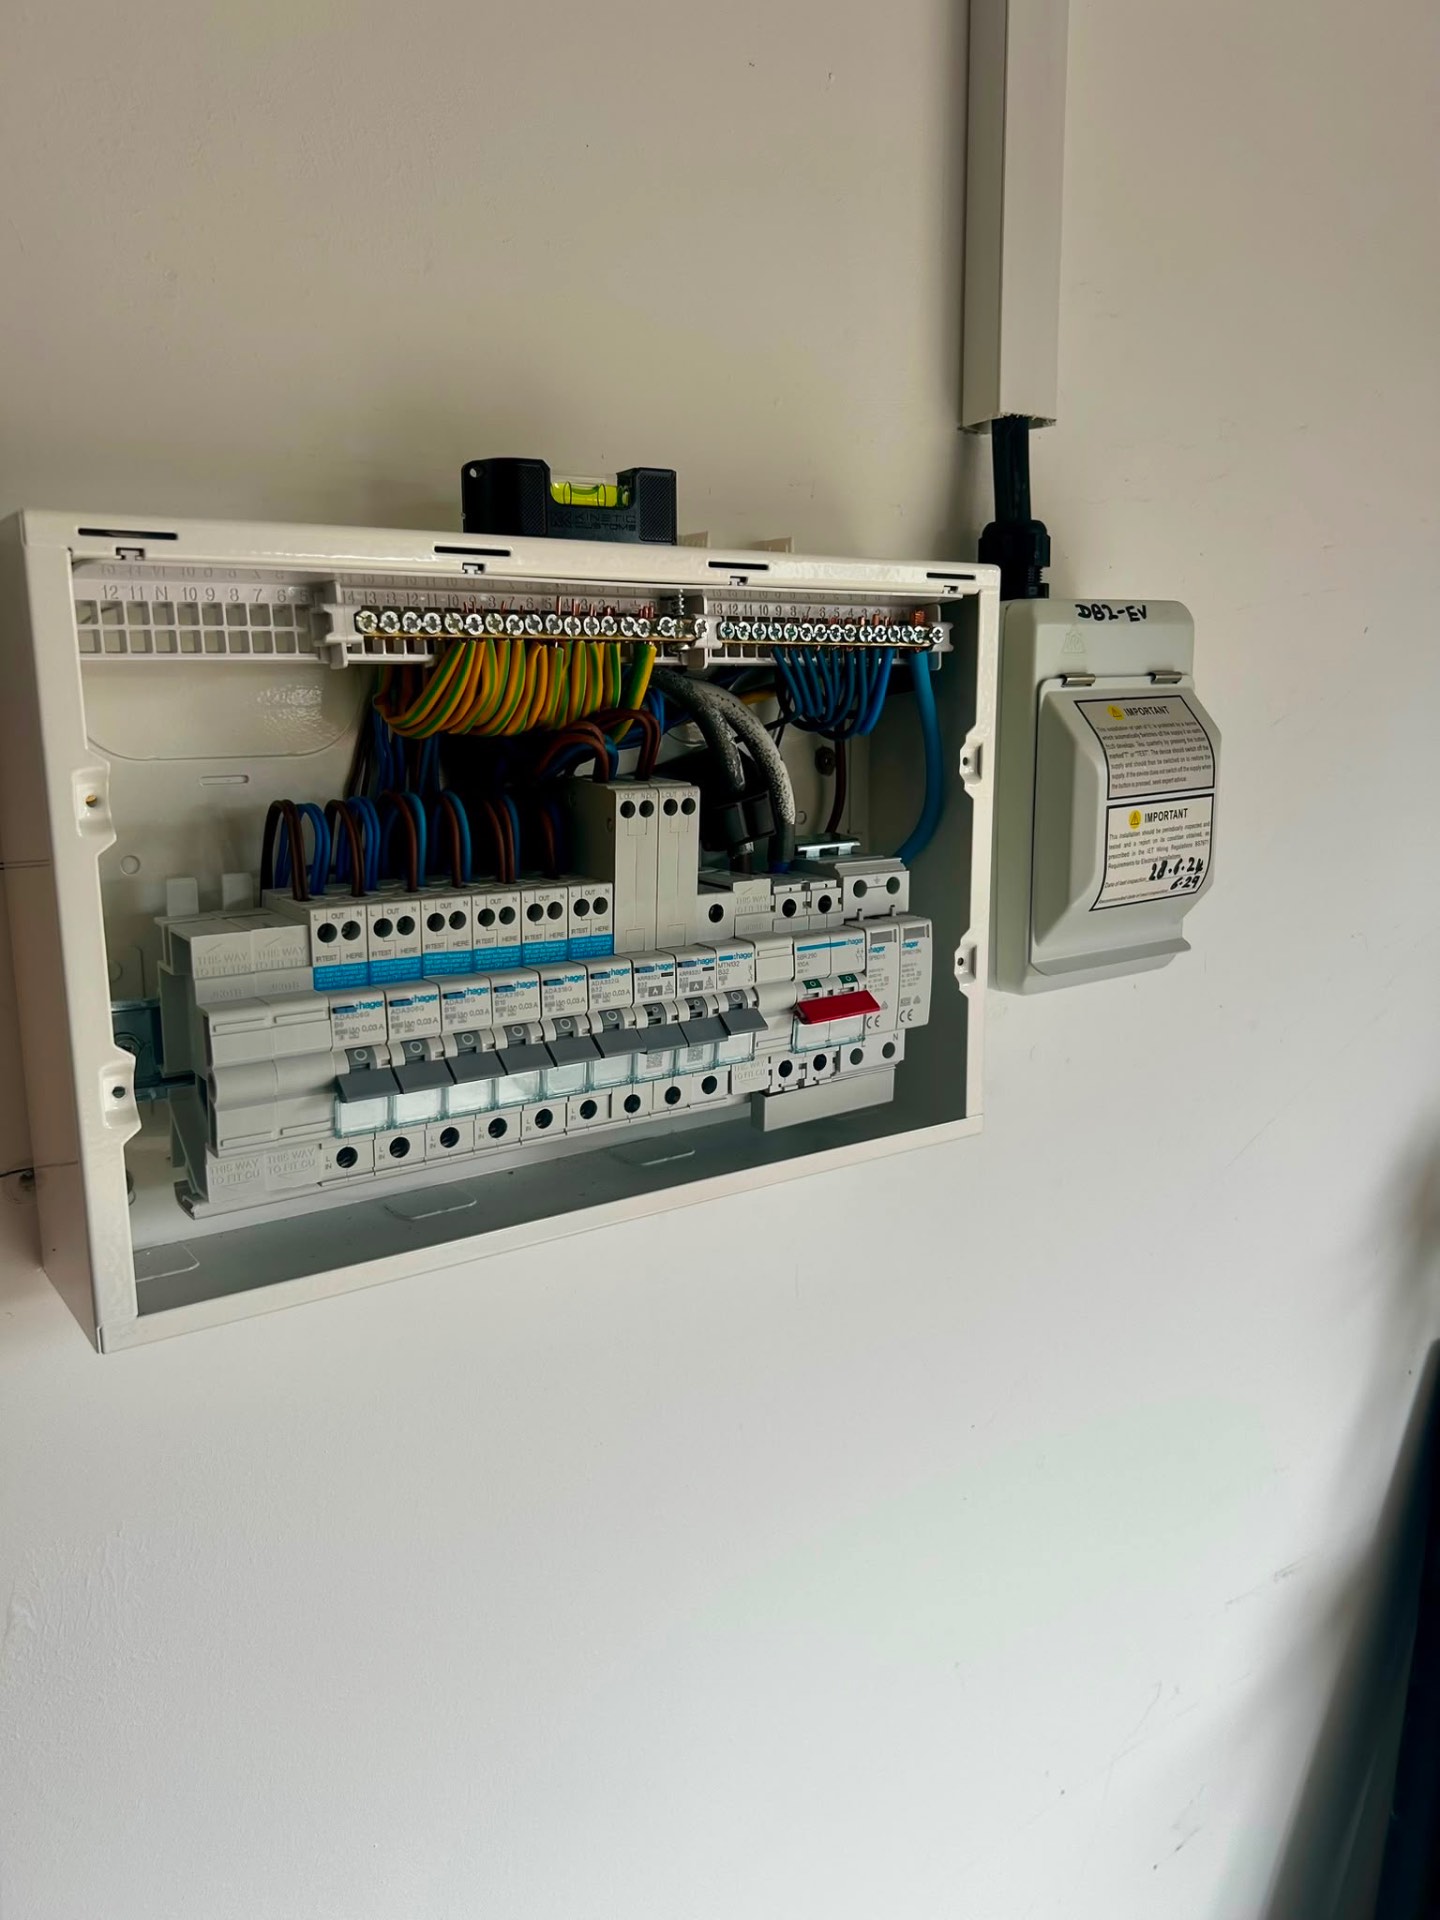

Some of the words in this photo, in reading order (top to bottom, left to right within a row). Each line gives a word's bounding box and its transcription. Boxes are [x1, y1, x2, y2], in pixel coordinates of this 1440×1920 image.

[575, 513, 636, 524] KINETIC
[103, 584, 119, 600] 12
[129, 585, 144, 601] 11
[155, 586, 168, 601] N
[181, 586, 198, 602] 10
[205, 587, 215, 602] 9
[229, 588, 239, 602] 8
[252, 588, 263, 603] 7
[276, 588, 287, 603] 6
[365, 591, 377, 605] 13
[406, 592, 419, 606] 12
[426, 592, 438, 607] 11
[447, 593, 459, 608] 10
[713, 603, 723, 615] 13
[728, 603, 739, 616] 12
[744, 604, 753, 616] 11
[759, 604, 769, 617] 10
[775, 605, 782, 617] 9
[790, 605, 797, 617] 8
[820, 606, 826, 619] 6
[1124, 706, 1170, 717] IMPORTANT
[1144, 808, 1188, 823] IMPORTANT
[313, 913, 319, 921] L
[330, 912, 345, 920] OUT
[453, 939, 470, 947] HERE
[401, 946, 418, 954] HERE
[346, 951, 365, 959] HERE
[736, 952, 753, 961] hager
[697, 957, 716, 966] hager
[655, 962, 674, 971] hager
[610, 967, 630, 976] hager
[564, 974, 586, 983] hager
[516, 980, 538, 989] hager
[466, 987, 490, 996] hager
[414, 994, 438, 1002] hager
[358, 1001, 383, 1009] hager
